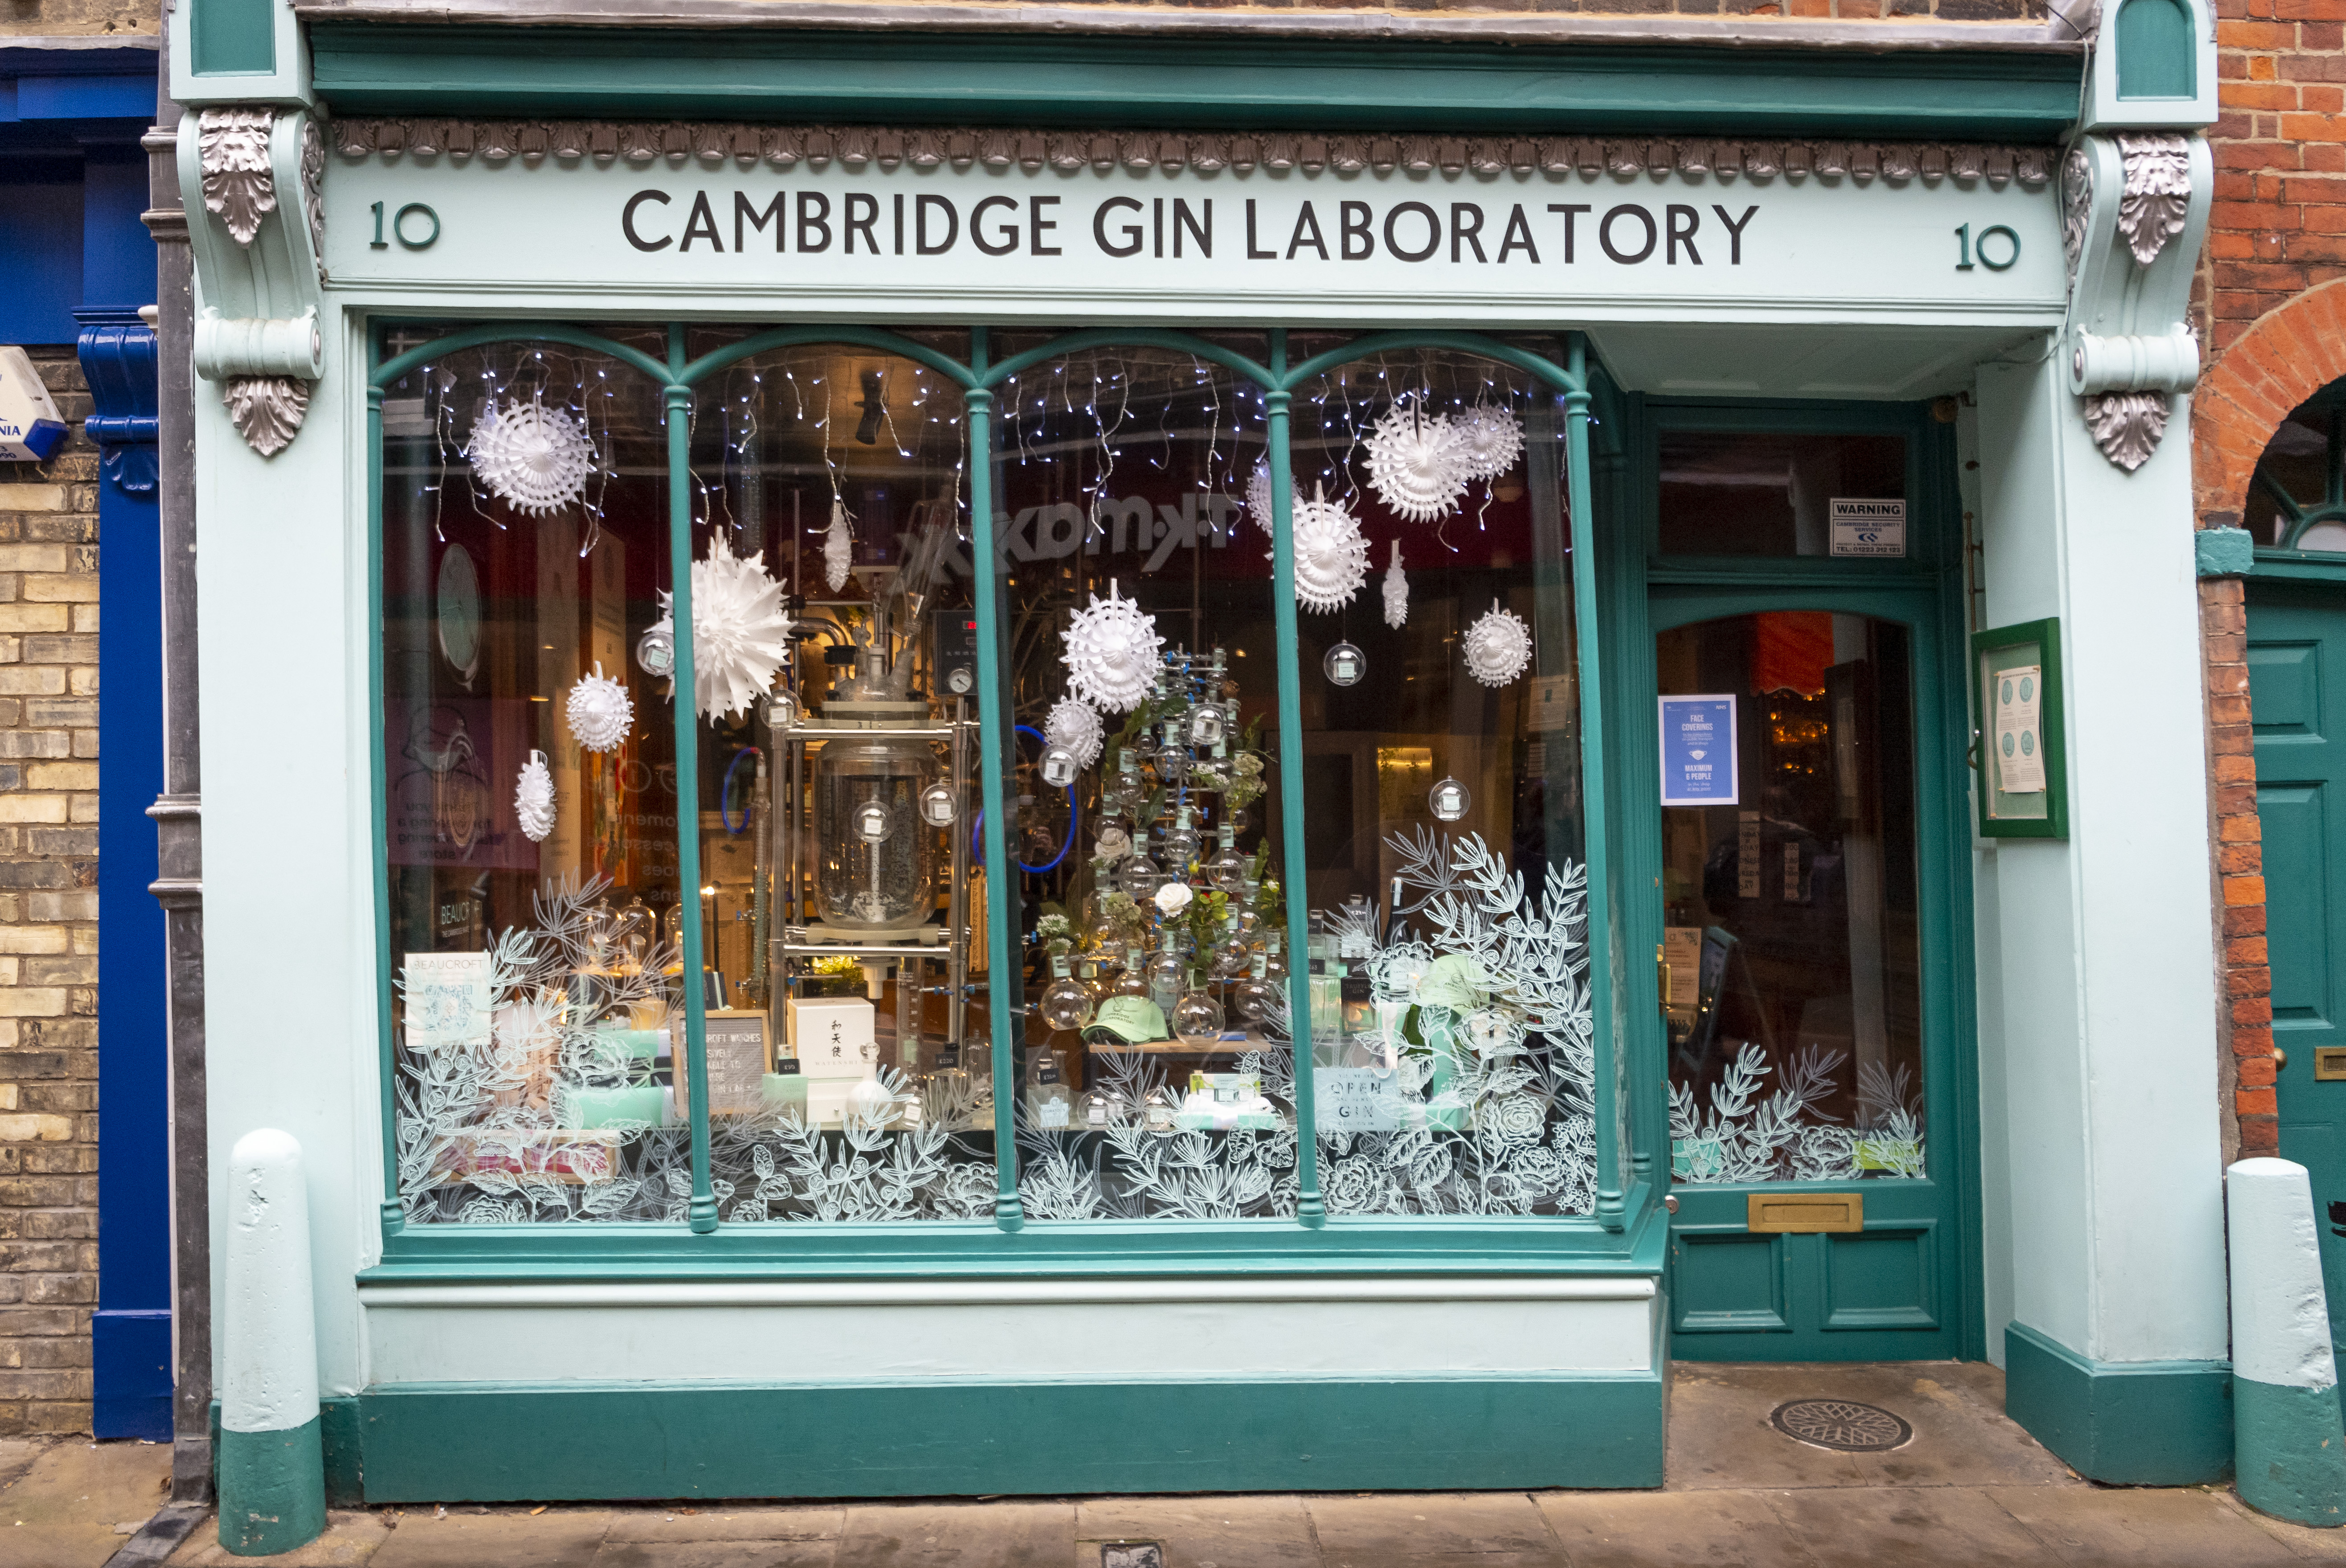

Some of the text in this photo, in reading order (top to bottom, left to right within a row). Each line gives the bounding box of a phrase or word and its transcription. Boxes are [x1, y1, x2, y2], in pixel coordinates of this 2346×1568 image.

[370, 200, 442, 251] 10
[622, 189, 1760, 267] CAMBRIDGE GIN LABORATORY
[1955, 222, 2021, 272] 10
[1836, 504, 1901, 515] WARNING
[1690, 714, 1704, 722] FACE
[1681, 723, 1713, 731] COVERINGS
[1339, 1105, 1373, 1118] GIN
